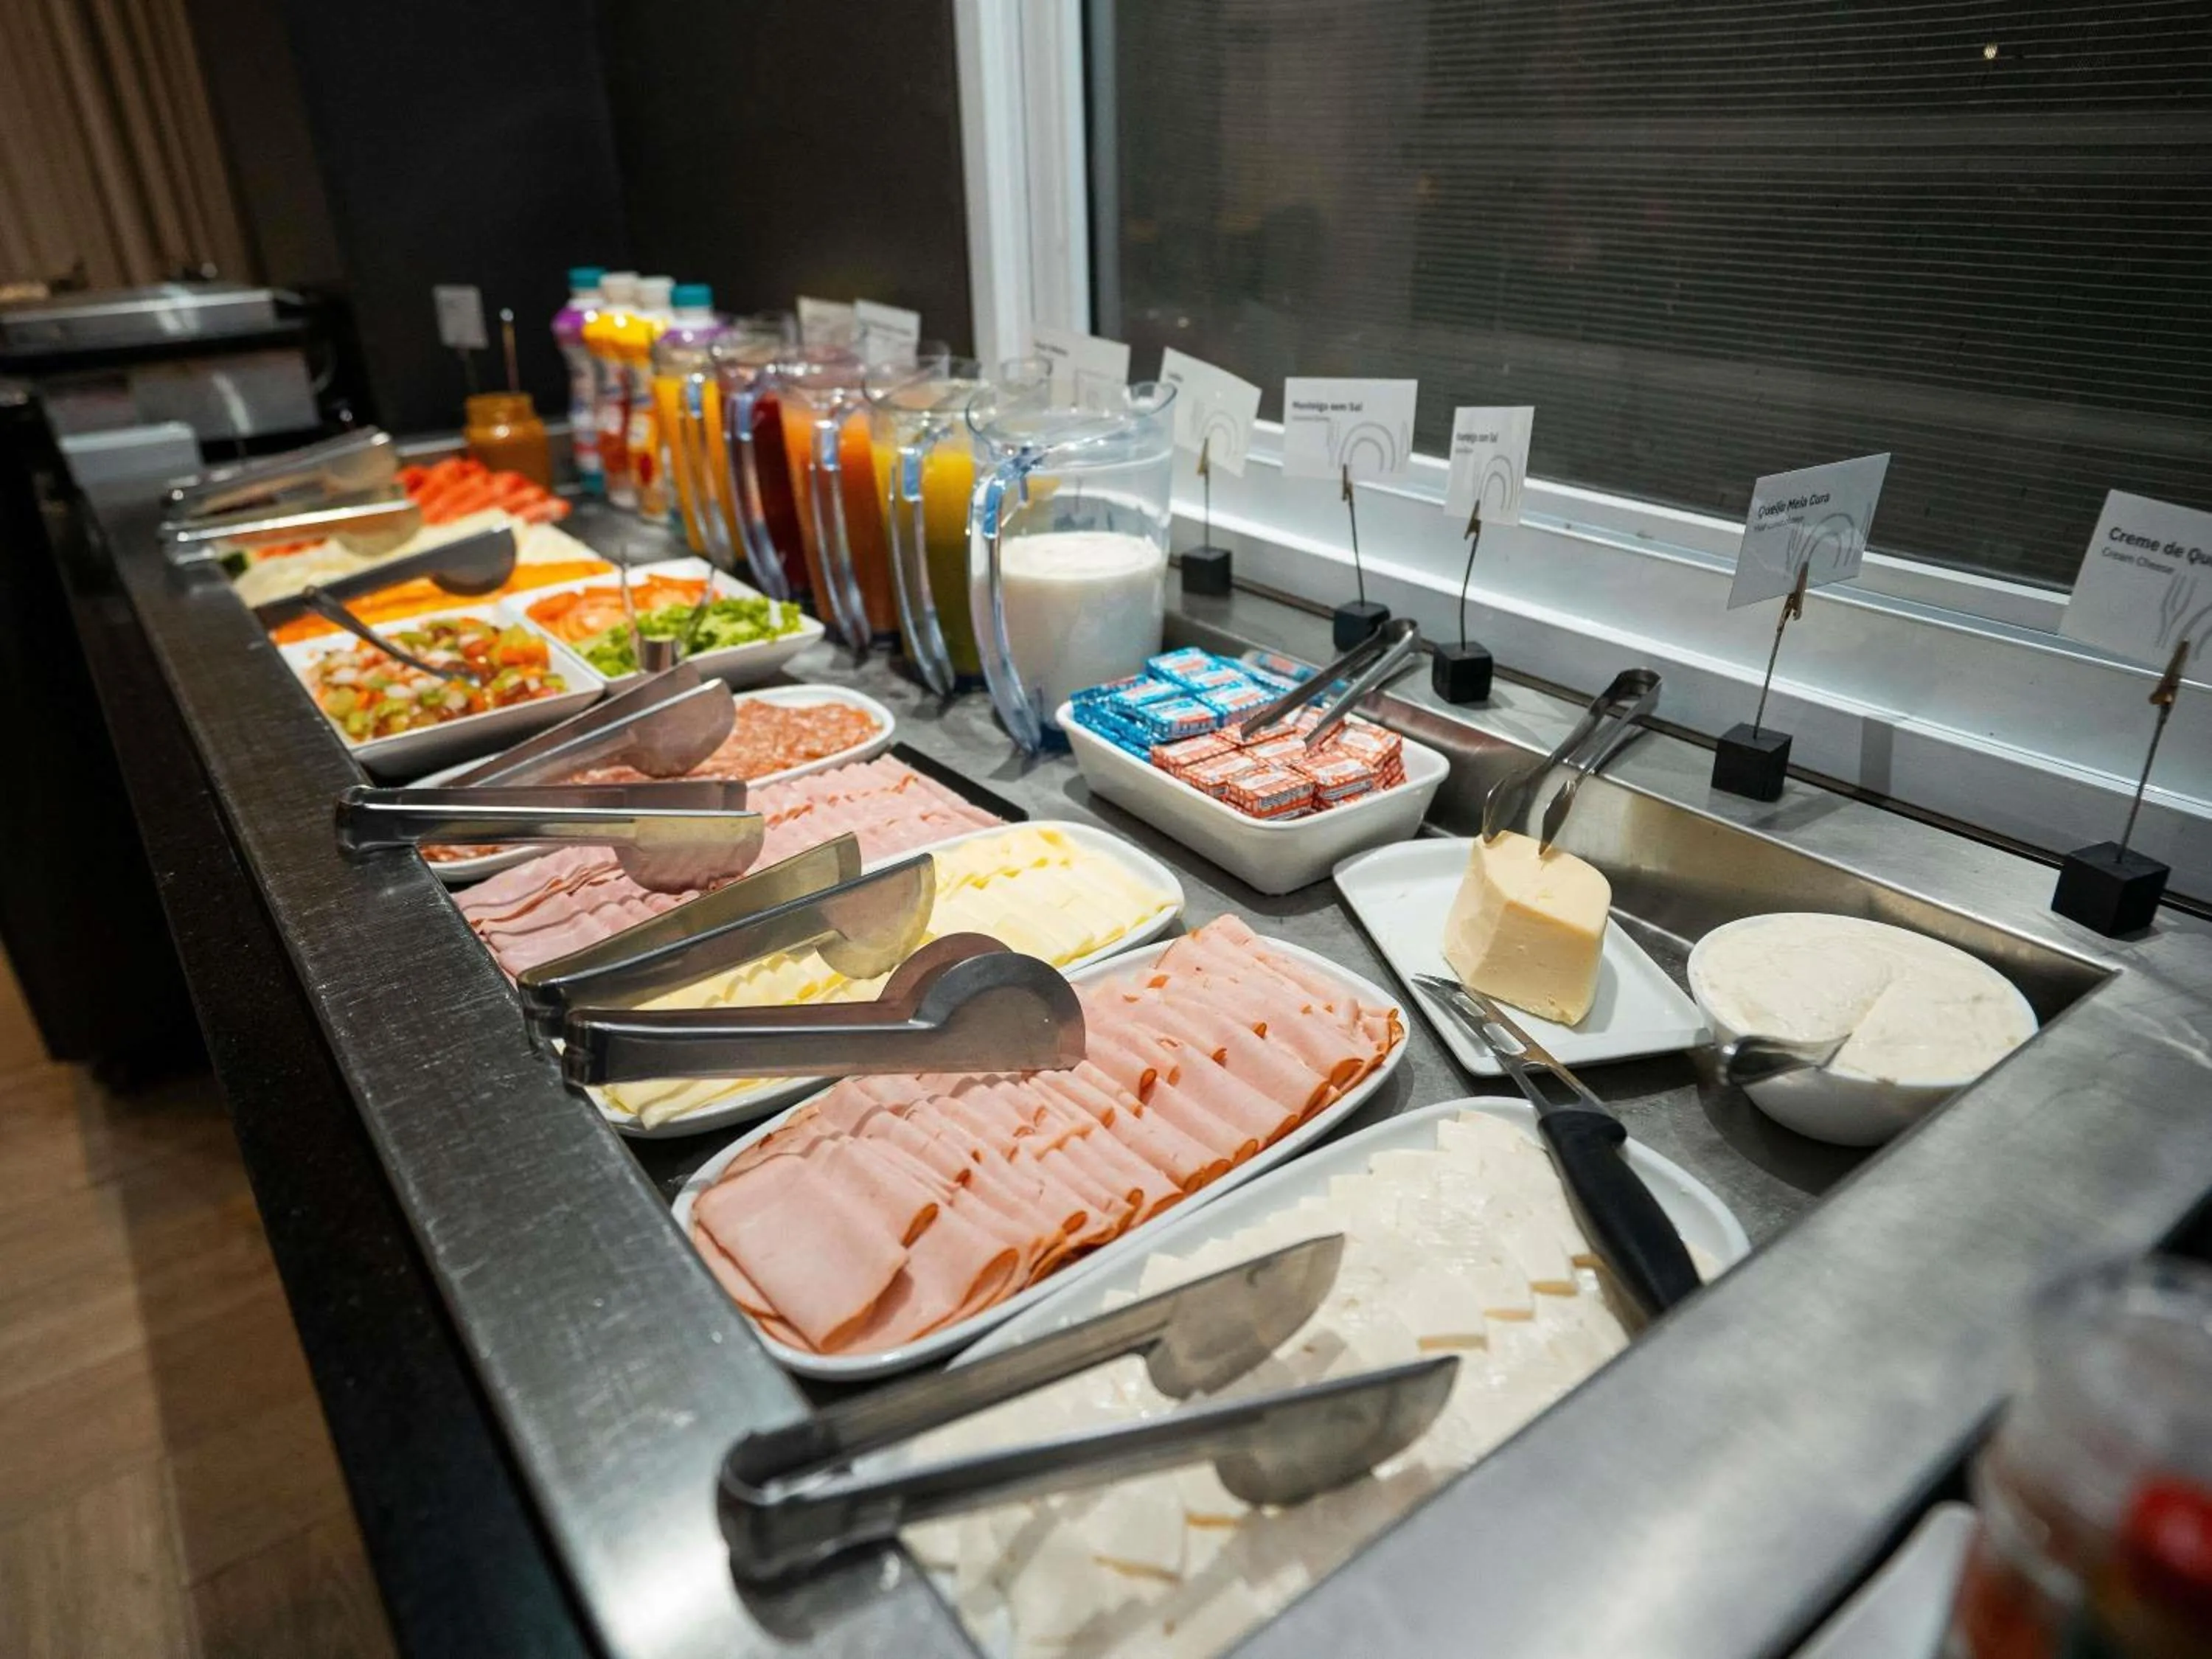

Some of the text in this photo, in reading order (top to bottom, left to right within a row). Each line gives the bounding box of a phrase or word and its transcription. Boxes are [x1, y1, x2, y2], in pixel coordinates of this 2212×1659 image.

[2110, 526, 2212, 566] Creme de Qu
